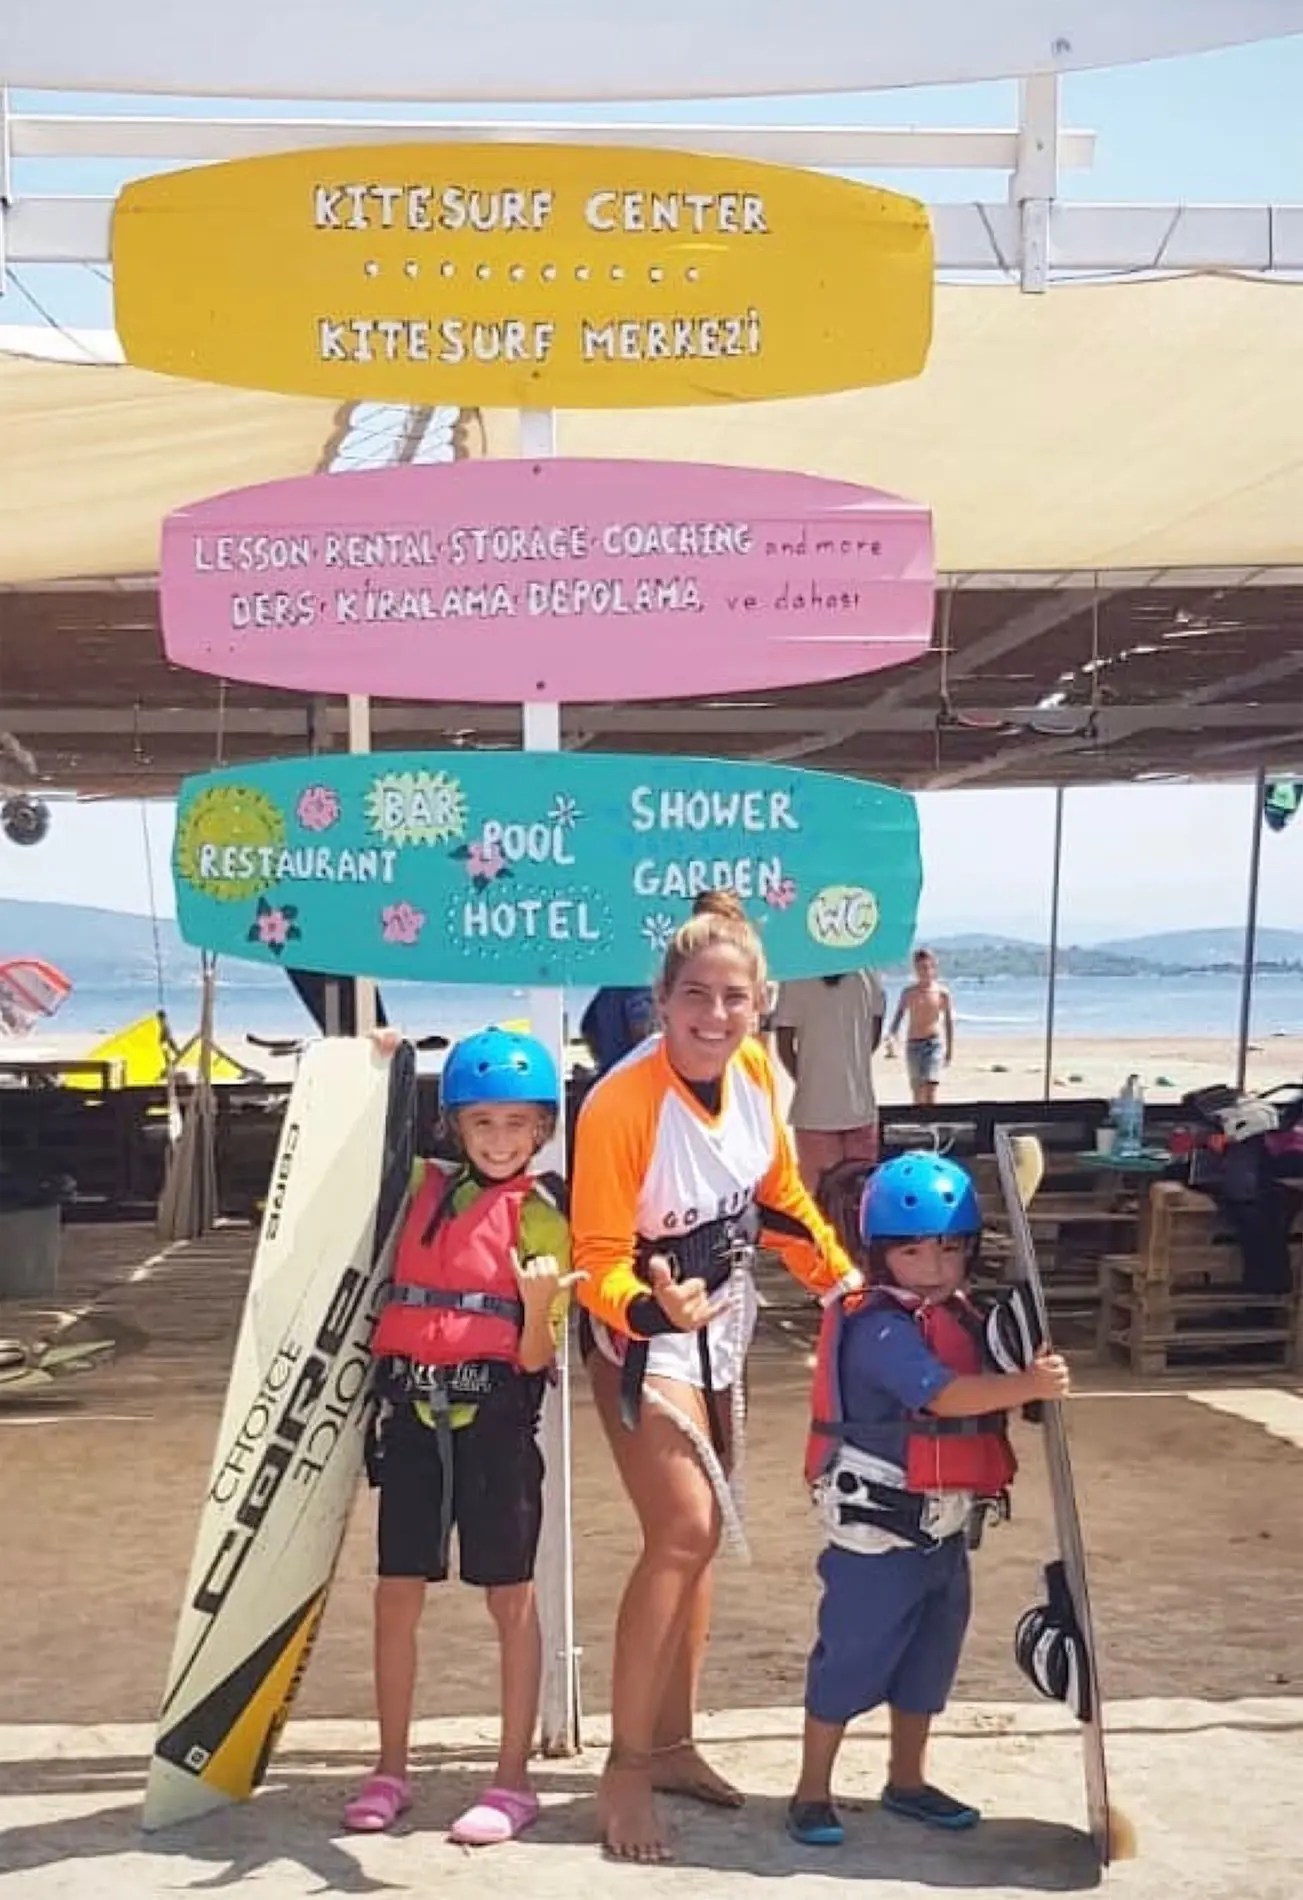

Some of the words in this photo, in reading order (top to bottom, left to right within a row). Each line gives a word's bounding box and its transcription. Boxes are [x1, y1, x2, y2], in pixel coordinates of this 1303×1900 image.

[314, 185, 553, 231] KITESURF
[584, 190, 771, 234] CENTER
[318, 319, 554, 363] KITESURF
[582, 306, 760, 361] MERKEZİ
[195, 536, 311, 572] LESSON
[325, 532, 438, 567] RENTAL
[449, 526, 590, 565] STORAGE
[602, 521, 751, 557] COACHING
[766, 525, 806, 556] and
[816, 539, 882, 556] more
[232, 592, 317, 629] DERS
[527, 577, 701, 617] DEPOLAMA
[728, 596, 758, 610] ve
[383, 786, 455, 829] BAR
[631, 785, 801, 832] SHOWER
[200, 844, 398, 883] RESTAURANT
[482, 819, 576, 866] POOL
[633, 858, 784, 899] GARDEN
[463, 900, 601, 939] HOTEL
[815, 893, 874, 937] WC
[663, 1207, 698, 1229] GO
[193, 1267, 370, 1615] CORE
[210, 1342, 302, 1504] CHOICE
